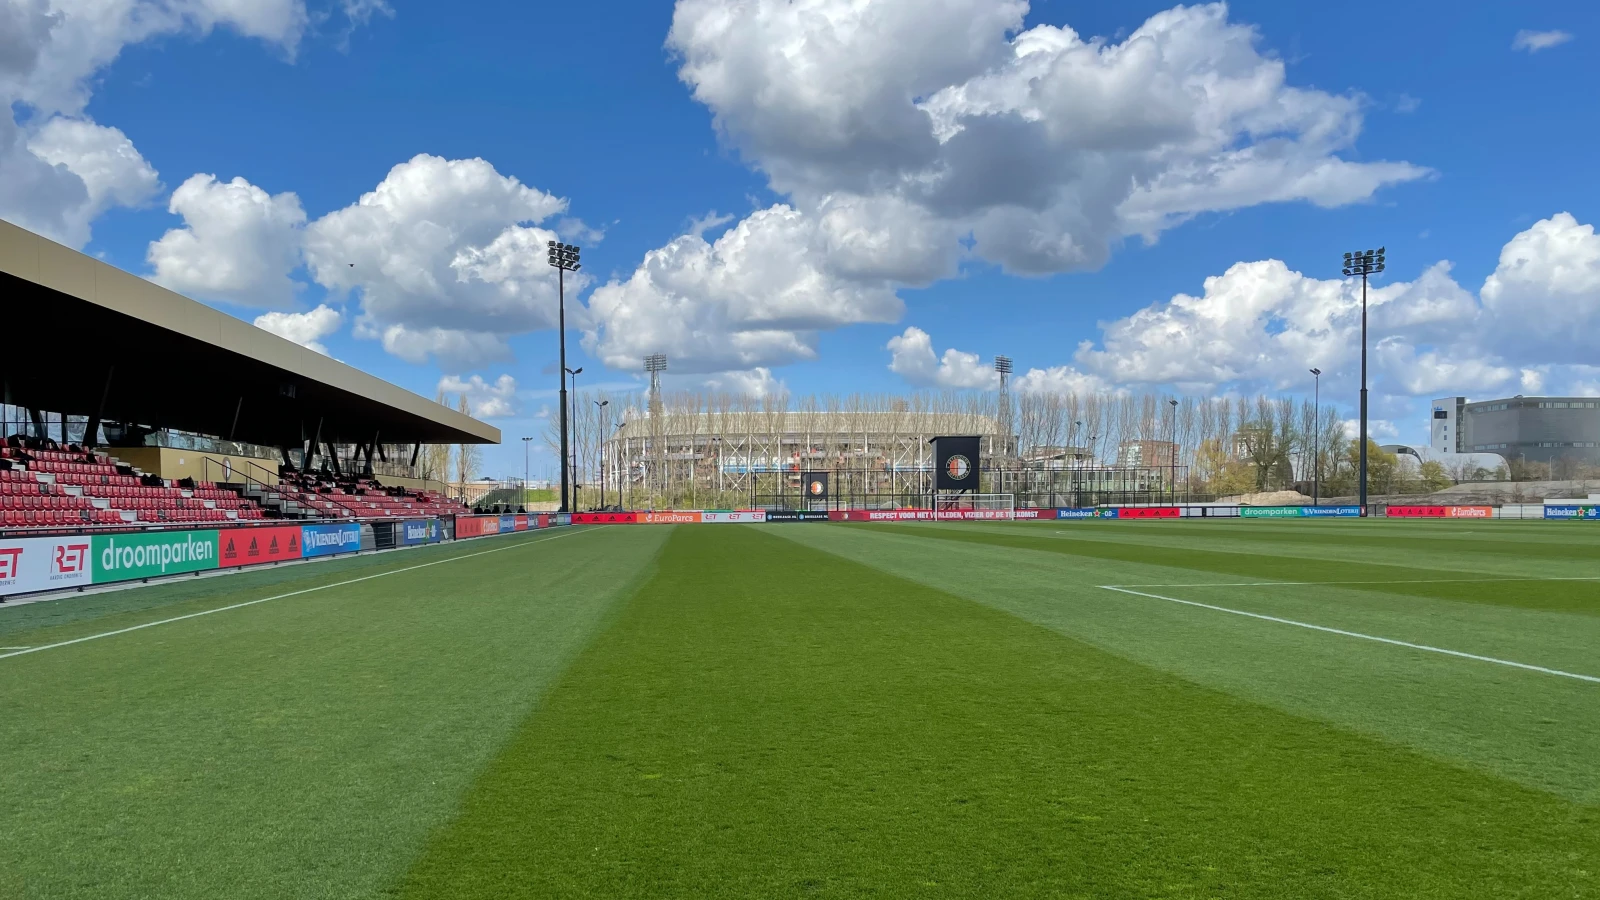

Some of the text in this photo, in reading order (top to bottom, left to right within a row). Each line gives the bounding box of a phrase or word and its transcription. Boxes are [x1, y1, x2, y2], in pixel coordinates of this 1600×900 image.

[1244, 507, 1297, 516] droomparken
[1457, 508, 1486, 516] EuroParcs
[1546, 508, 1577, 516] Heineken
[654, 514, 694, 522] EuroParcs
[102, 533, 213, 573] droomparken
[0, 547, 24, 579] ET
[50, 543, 89, 574] RET
